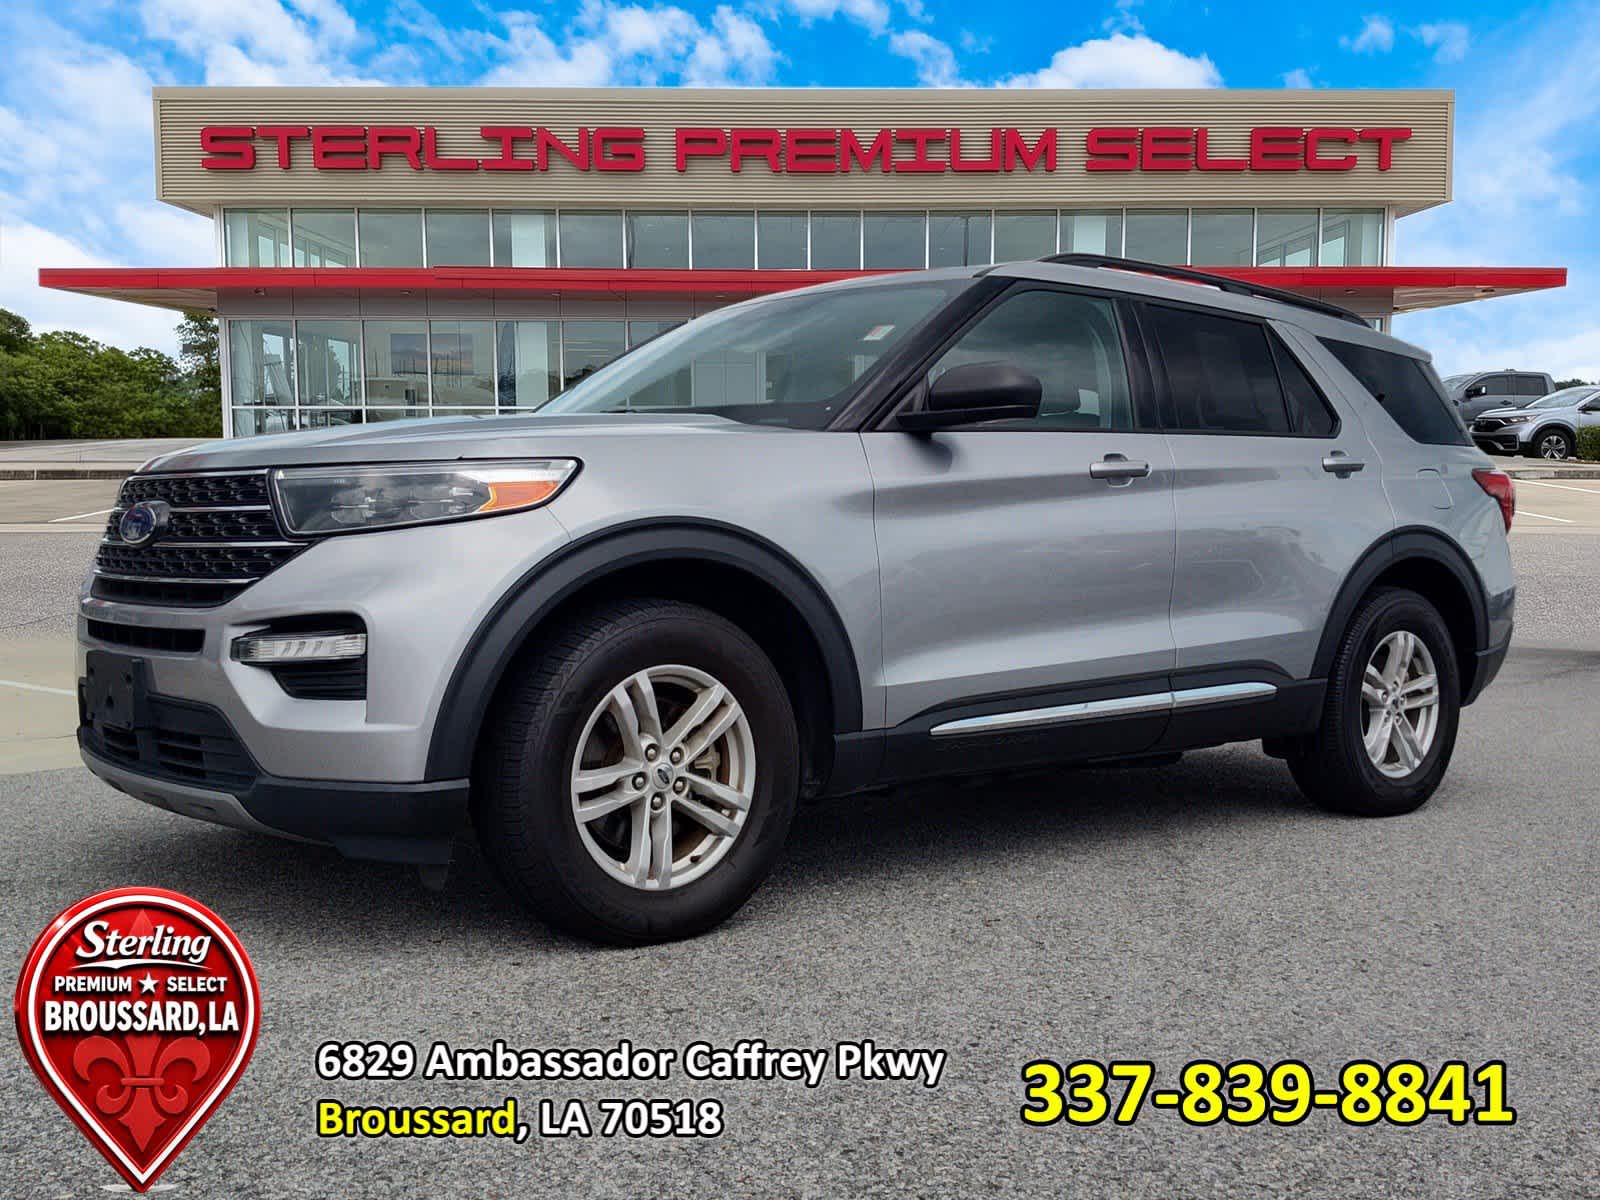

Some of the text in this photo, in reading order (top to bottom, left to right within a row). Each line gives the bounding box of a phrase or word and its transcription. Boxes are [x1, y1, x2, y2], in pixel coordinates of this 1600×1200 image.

[201, 126, 1412, 173] STERLING PREMIUM SELECT
